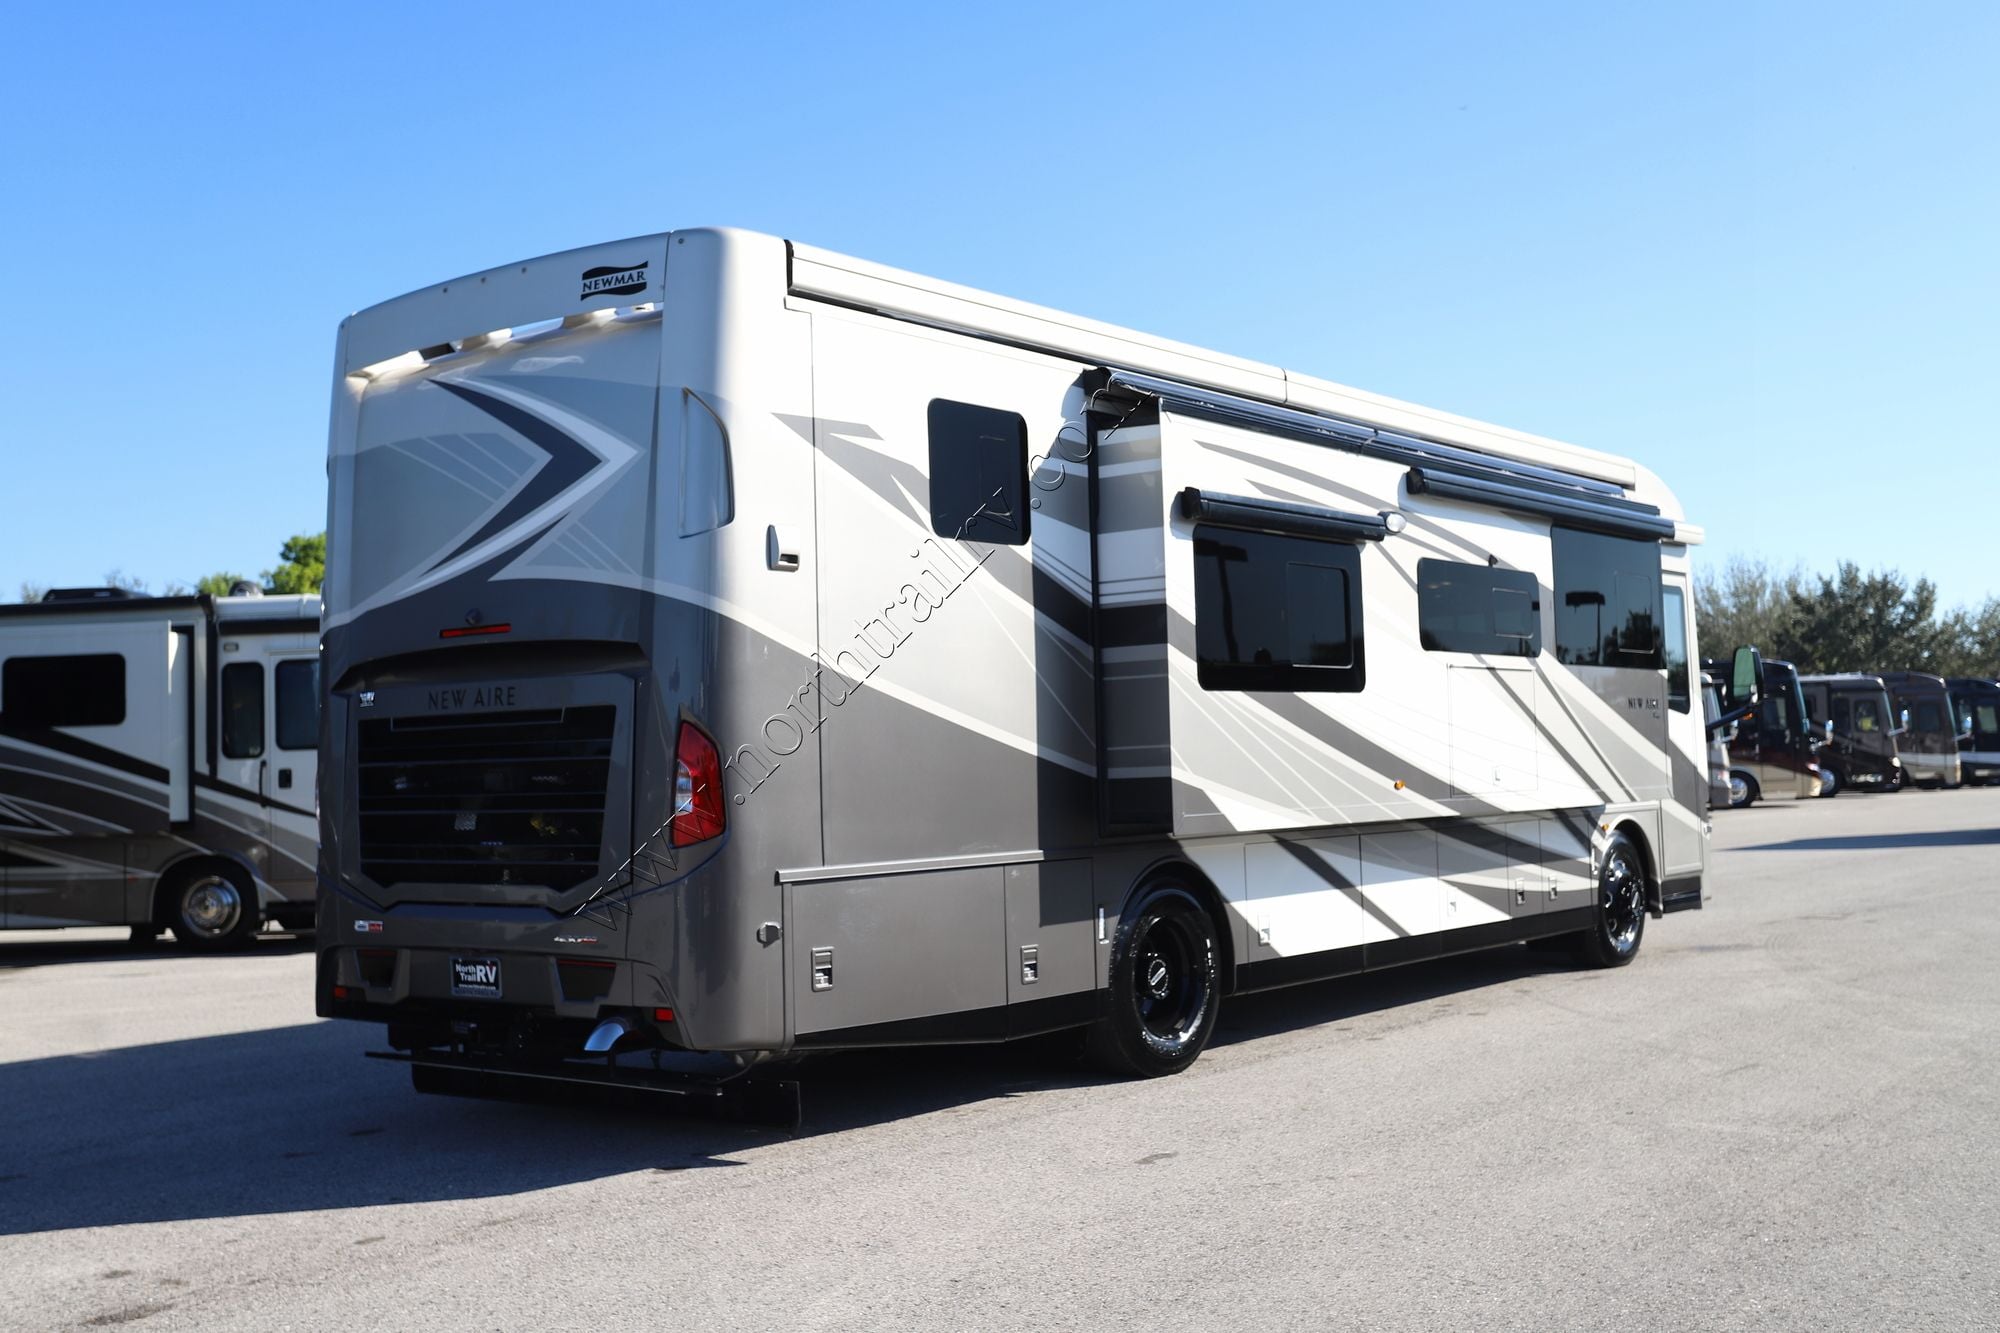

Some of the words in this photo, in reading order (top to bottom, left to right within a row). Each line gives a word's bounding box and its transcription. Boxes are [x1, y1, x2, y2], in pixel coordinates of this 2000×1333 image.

[582, 270, 647, 293] NEWMAR
[428, 688, 467, 711] NEW
[473, 686, 516, 707] AIRE
[455, 963, 476, 973] North
[460, 972, 477, 982] Trail
[475, 964, 497, 984] RV
